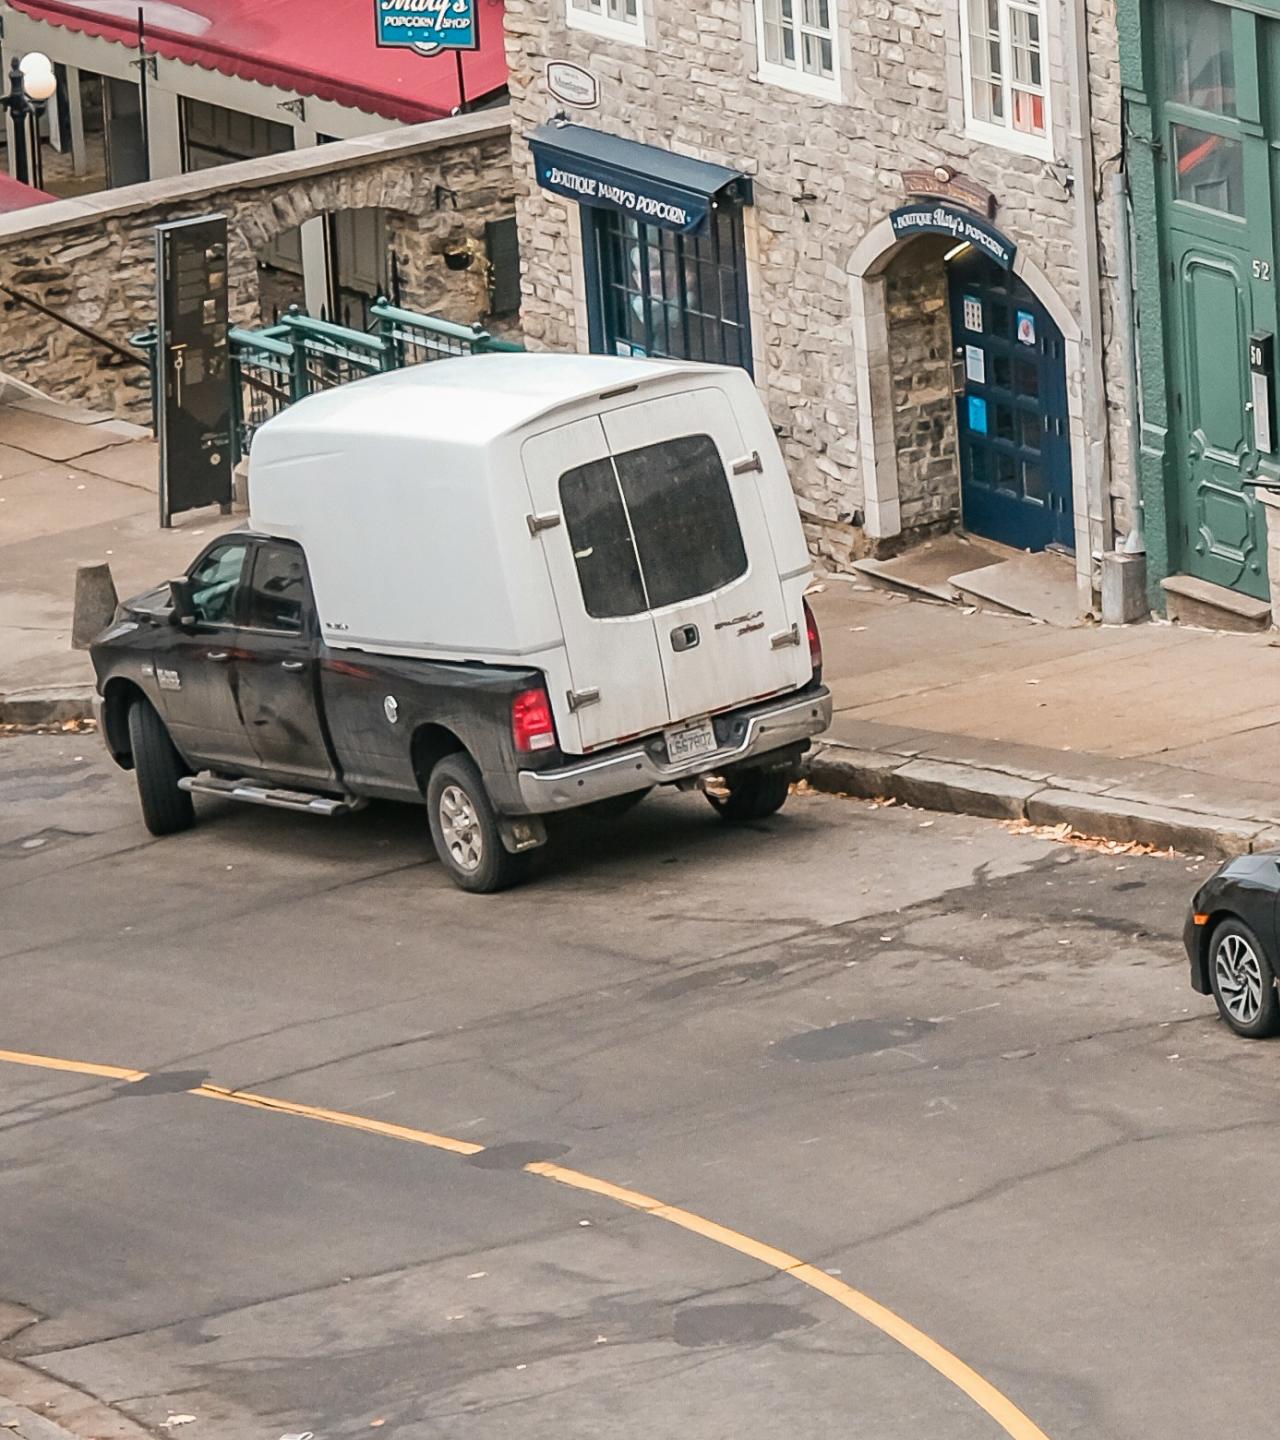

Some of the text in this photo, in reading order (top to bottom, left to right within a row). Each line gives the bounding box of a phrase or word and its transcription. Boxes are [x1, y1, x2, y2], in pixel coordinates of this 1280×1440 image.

[384, 16, 471, 28] POPCORN SHOP
[551, 167, 687, 225] BOUTIQUE MARY'S POPCORN
[896, 212, 933, 229] BOUTIQUE
[965, 223, 1005, 257] POPCORN
[1252, 259, 1271, 281] 52
[1250, 345, 1263, 366] 50
